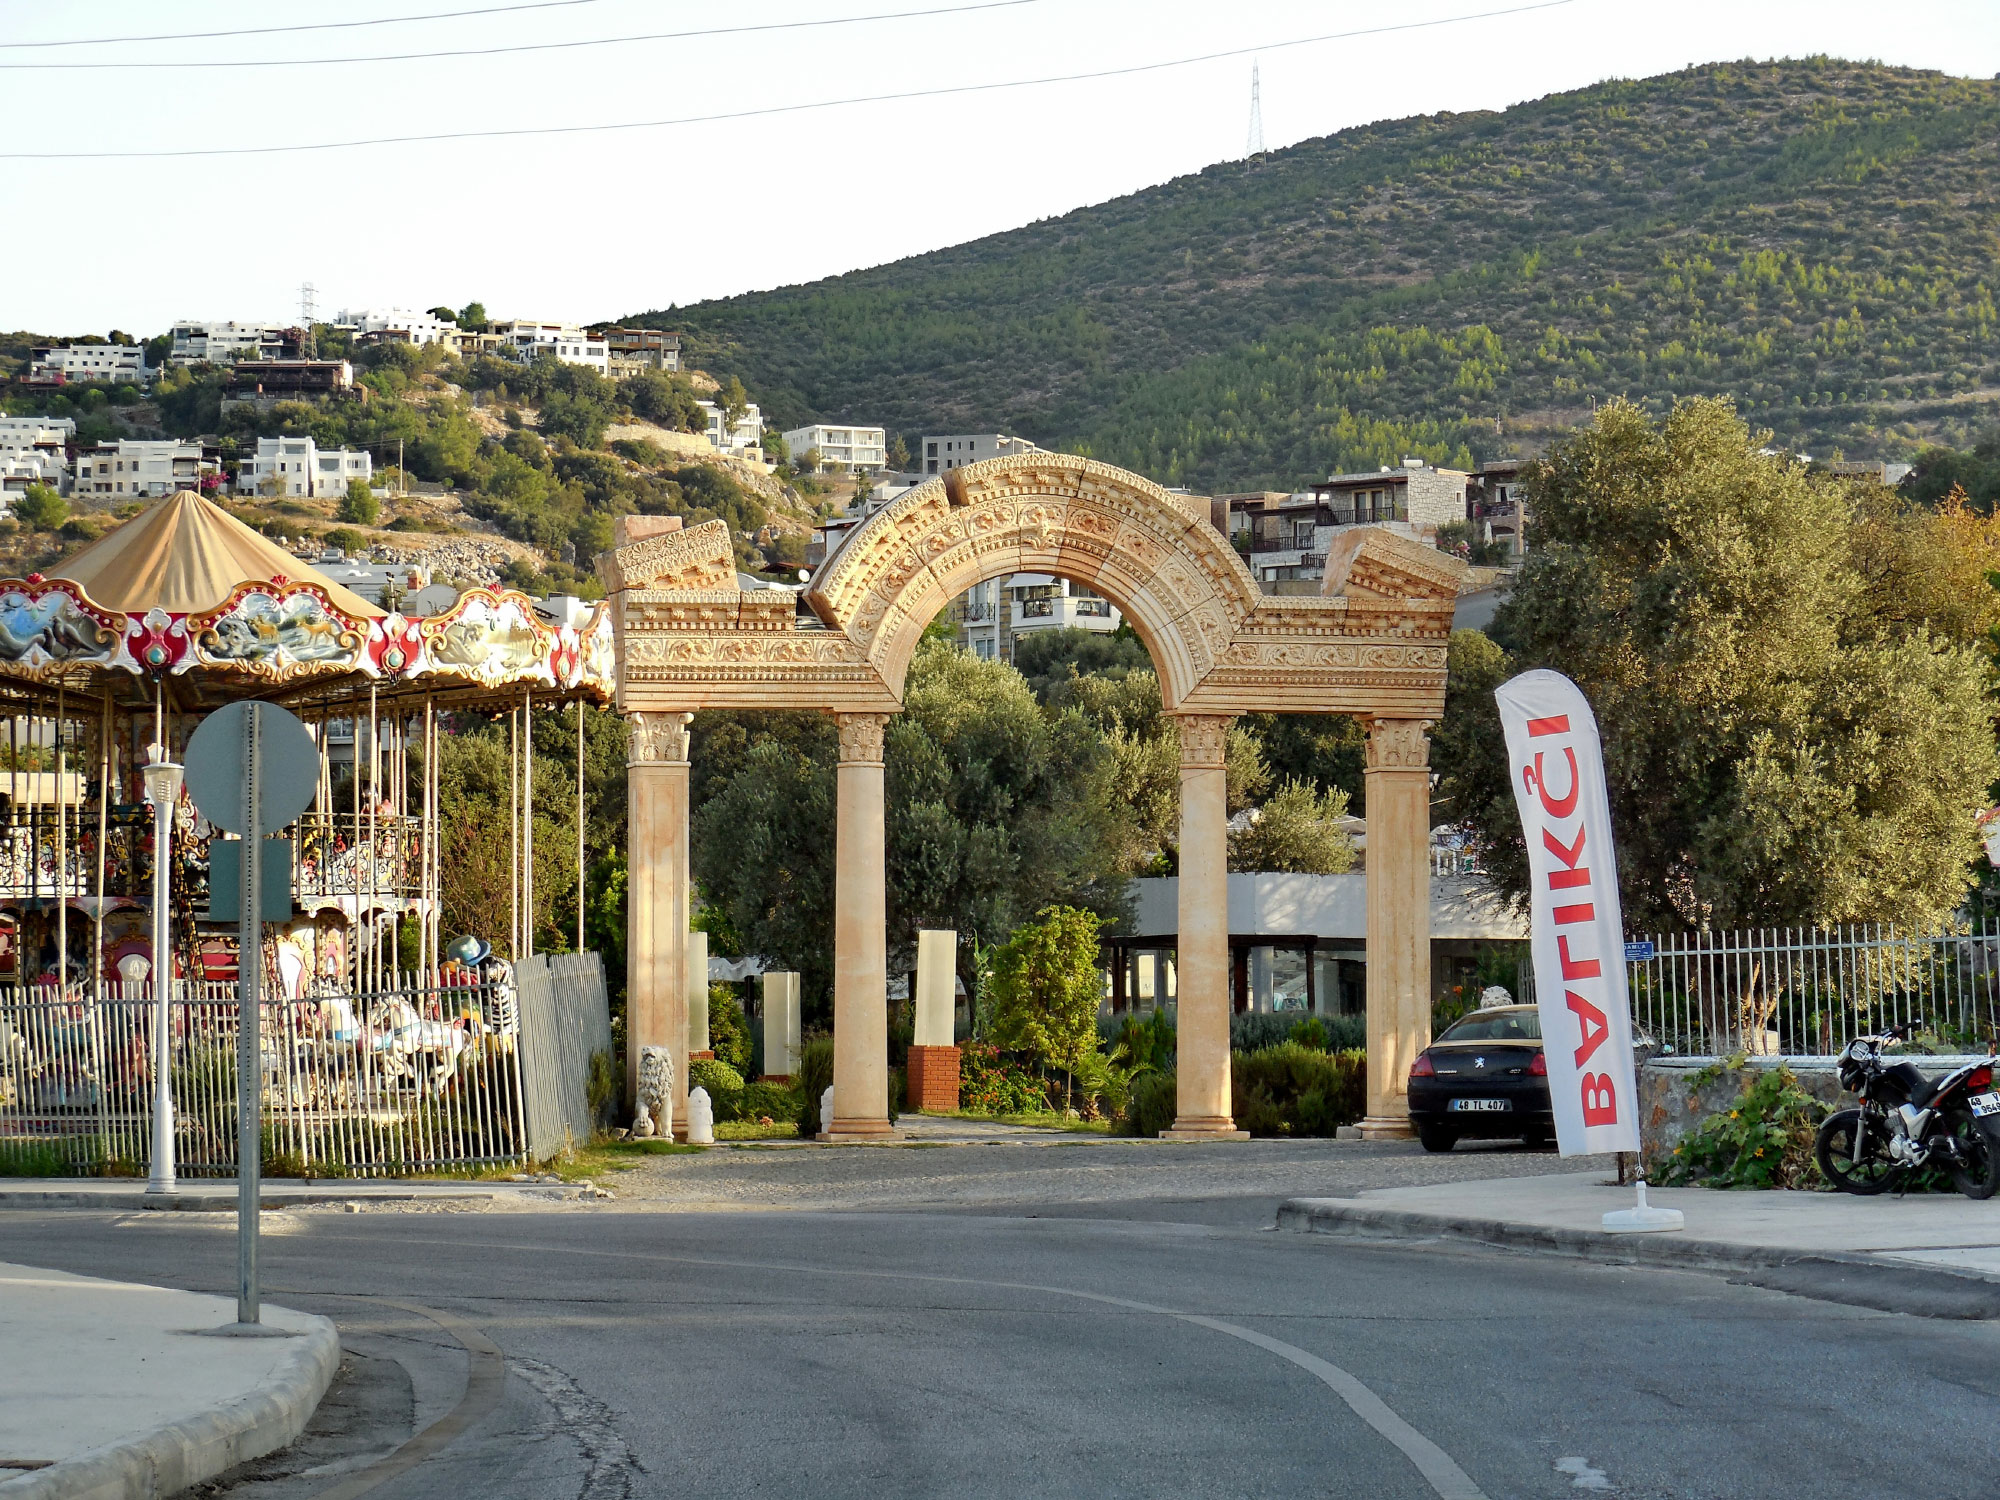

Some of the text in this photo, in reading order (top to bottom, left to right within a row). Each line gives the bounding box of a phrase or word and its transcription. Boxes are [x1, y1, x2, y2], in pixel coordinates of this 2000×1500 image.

[1522, 715, 1617, 1127] BALIKÇI
[1459, 1101, 1504, 1110] 48 TL 407
[1971, 1097, 1982, 1106] 48
